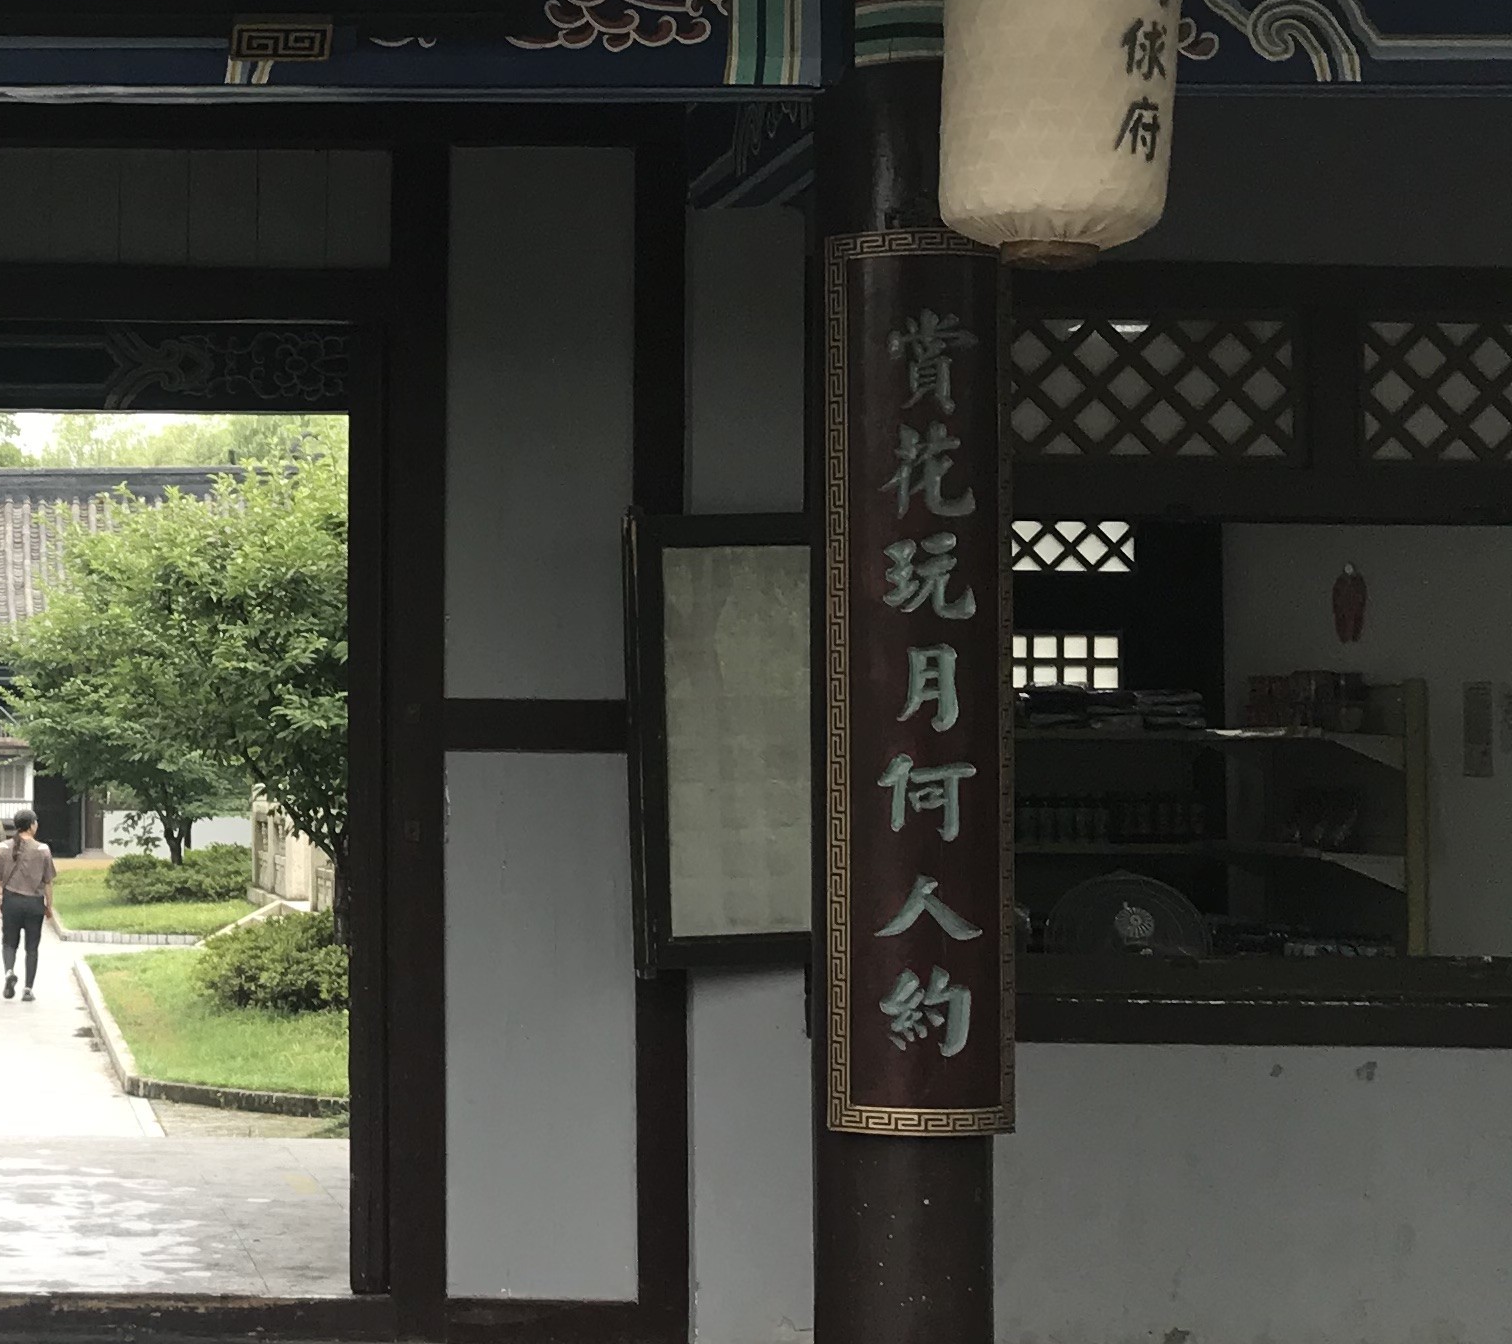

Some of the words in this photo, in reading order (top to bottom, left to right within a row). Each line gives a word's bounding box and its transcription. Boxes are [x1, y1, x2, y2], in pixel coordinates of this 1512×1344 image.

[873, 306, 983, 1059] 賞花玩月何人約
